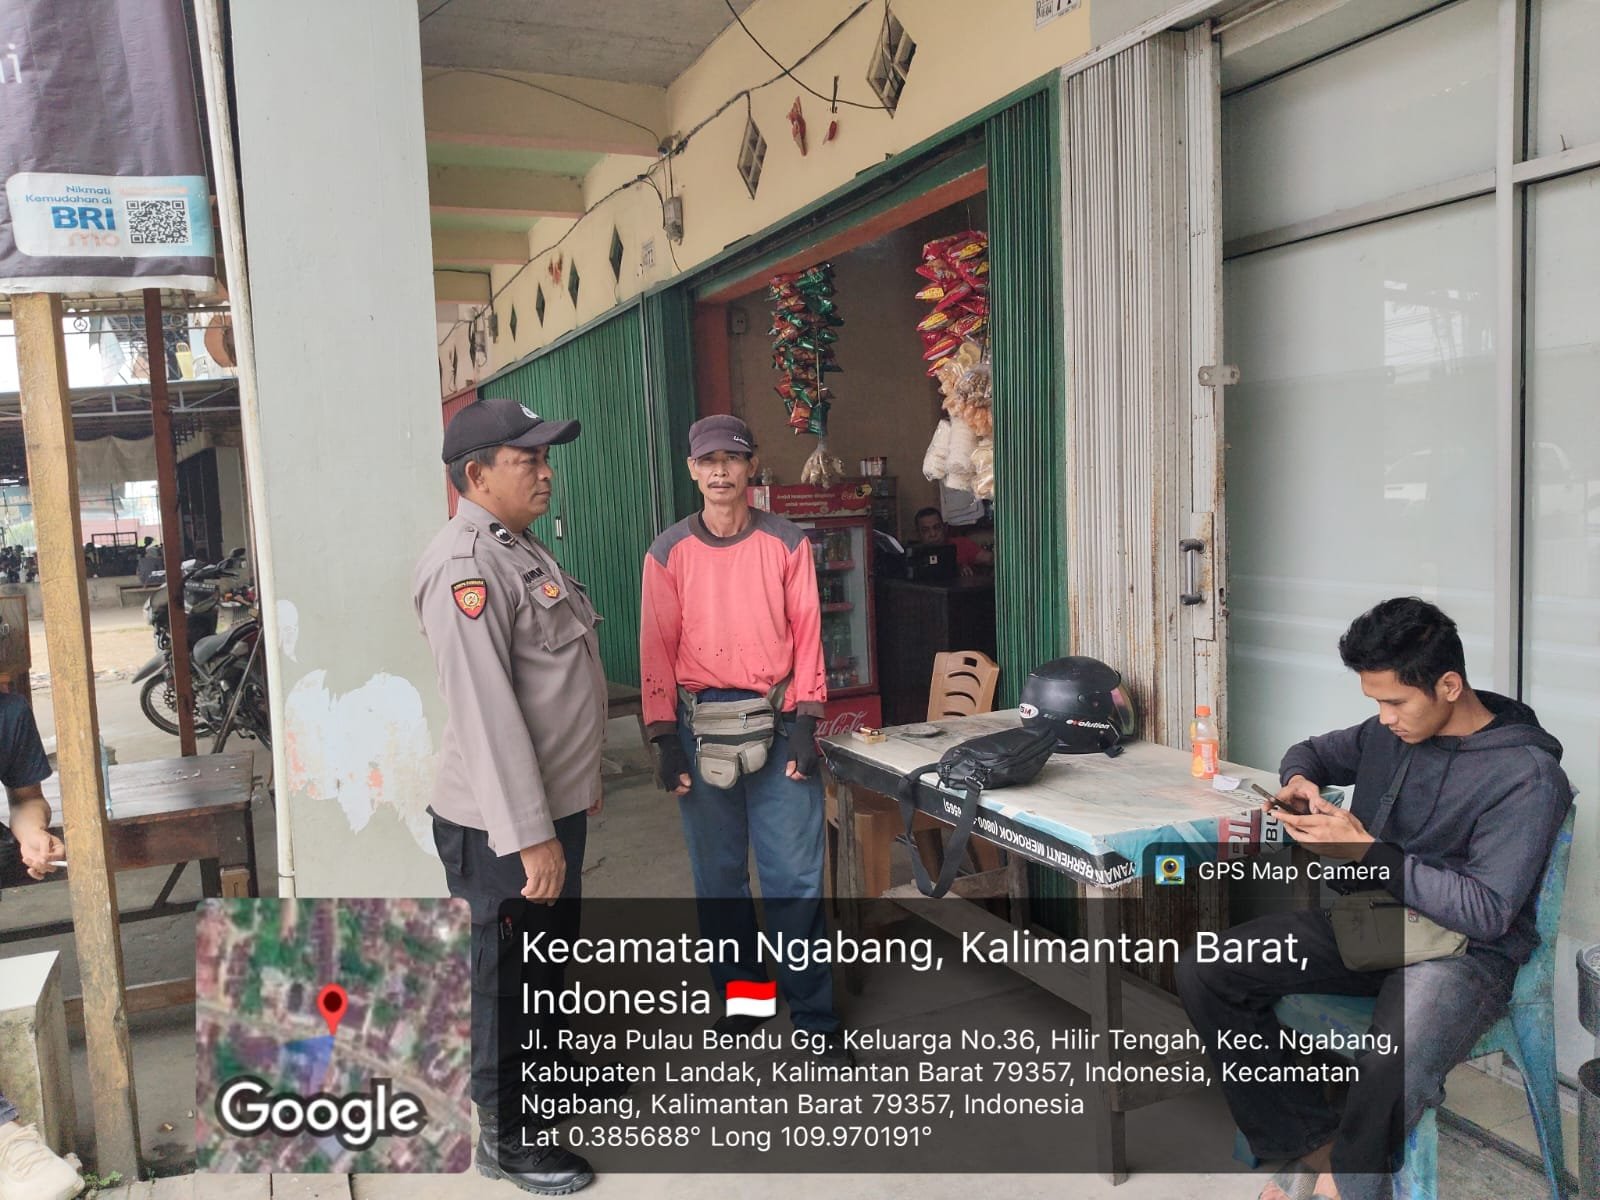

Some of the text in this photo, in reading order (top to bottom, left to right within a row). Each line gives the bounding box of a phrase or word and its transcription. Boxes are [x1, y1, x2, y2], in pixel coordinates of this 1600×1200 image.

[25, 194, 112, 205] Kemudahan di
[65, 184, 111, 195] Nikmati
[51, 206, 116, 231] BRI
[999, 827, 1046, 856] MEROKOK
[1046, 846, 1095, 879] BERHENTI
